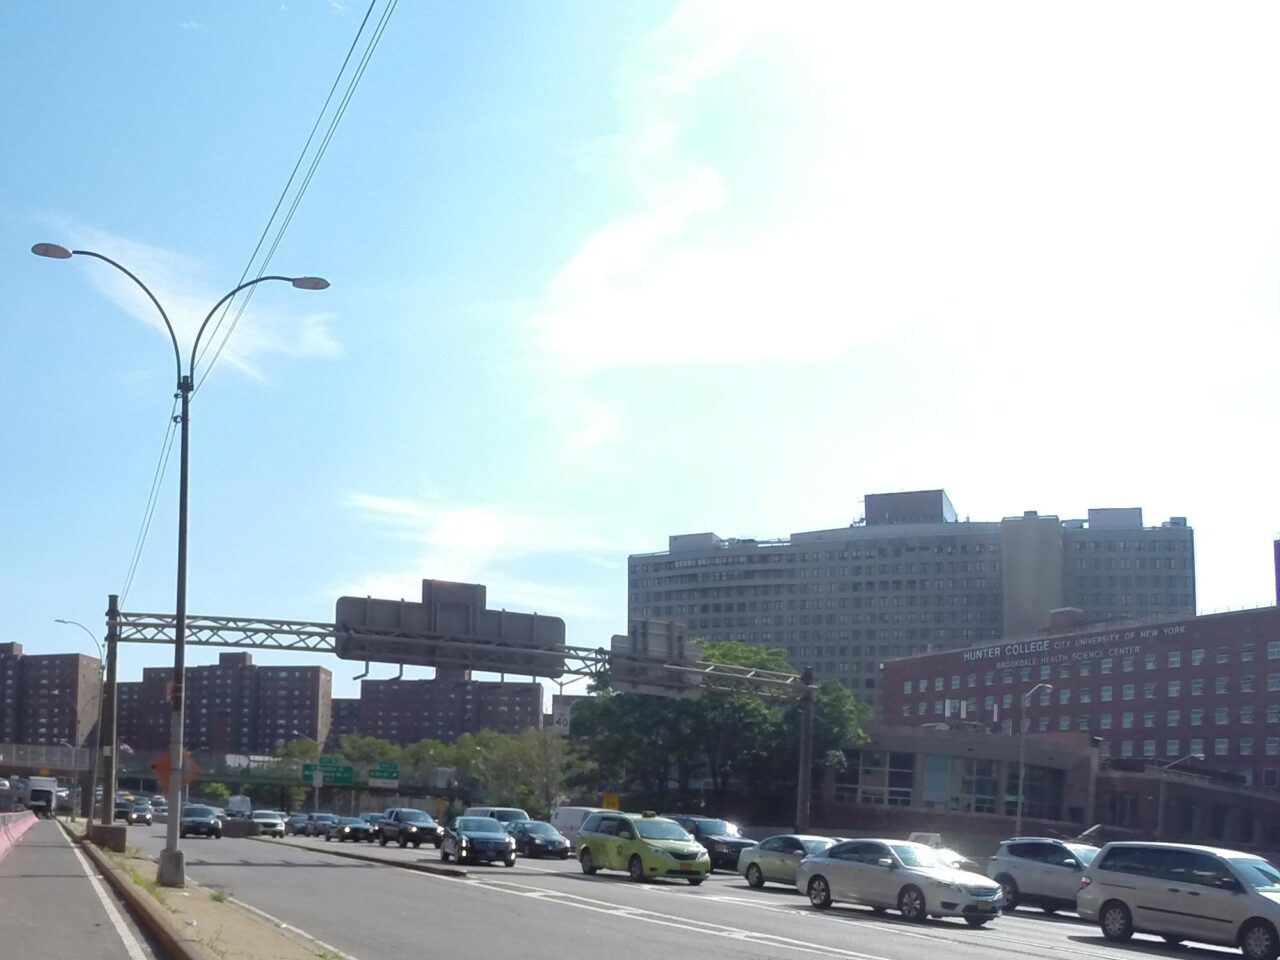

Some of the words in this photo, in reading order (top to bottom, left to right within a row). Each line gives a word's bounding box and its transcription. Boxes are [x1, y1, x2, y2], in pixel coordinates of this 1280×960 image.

[963, 647, 1001, 661] HUNTER
[1005, 640, 1050, 656] COLLEGE
[1054, 640, 1071, 649] CITY
[1075, 633, 1120, 647] UNIVERSITY
[1124, 631, 1136, 640] OF
[1140, 628, 1159, 639] NEW
[1163, 625, 1186, 636] YORK
[996, 657, 1036, 670] BROOKDALE
[1041, 655, 1068, 664] HEALTH
[1072, 649, 1105, 661] SCIENCE
[1109, 645, 1140, 657] CENTER
